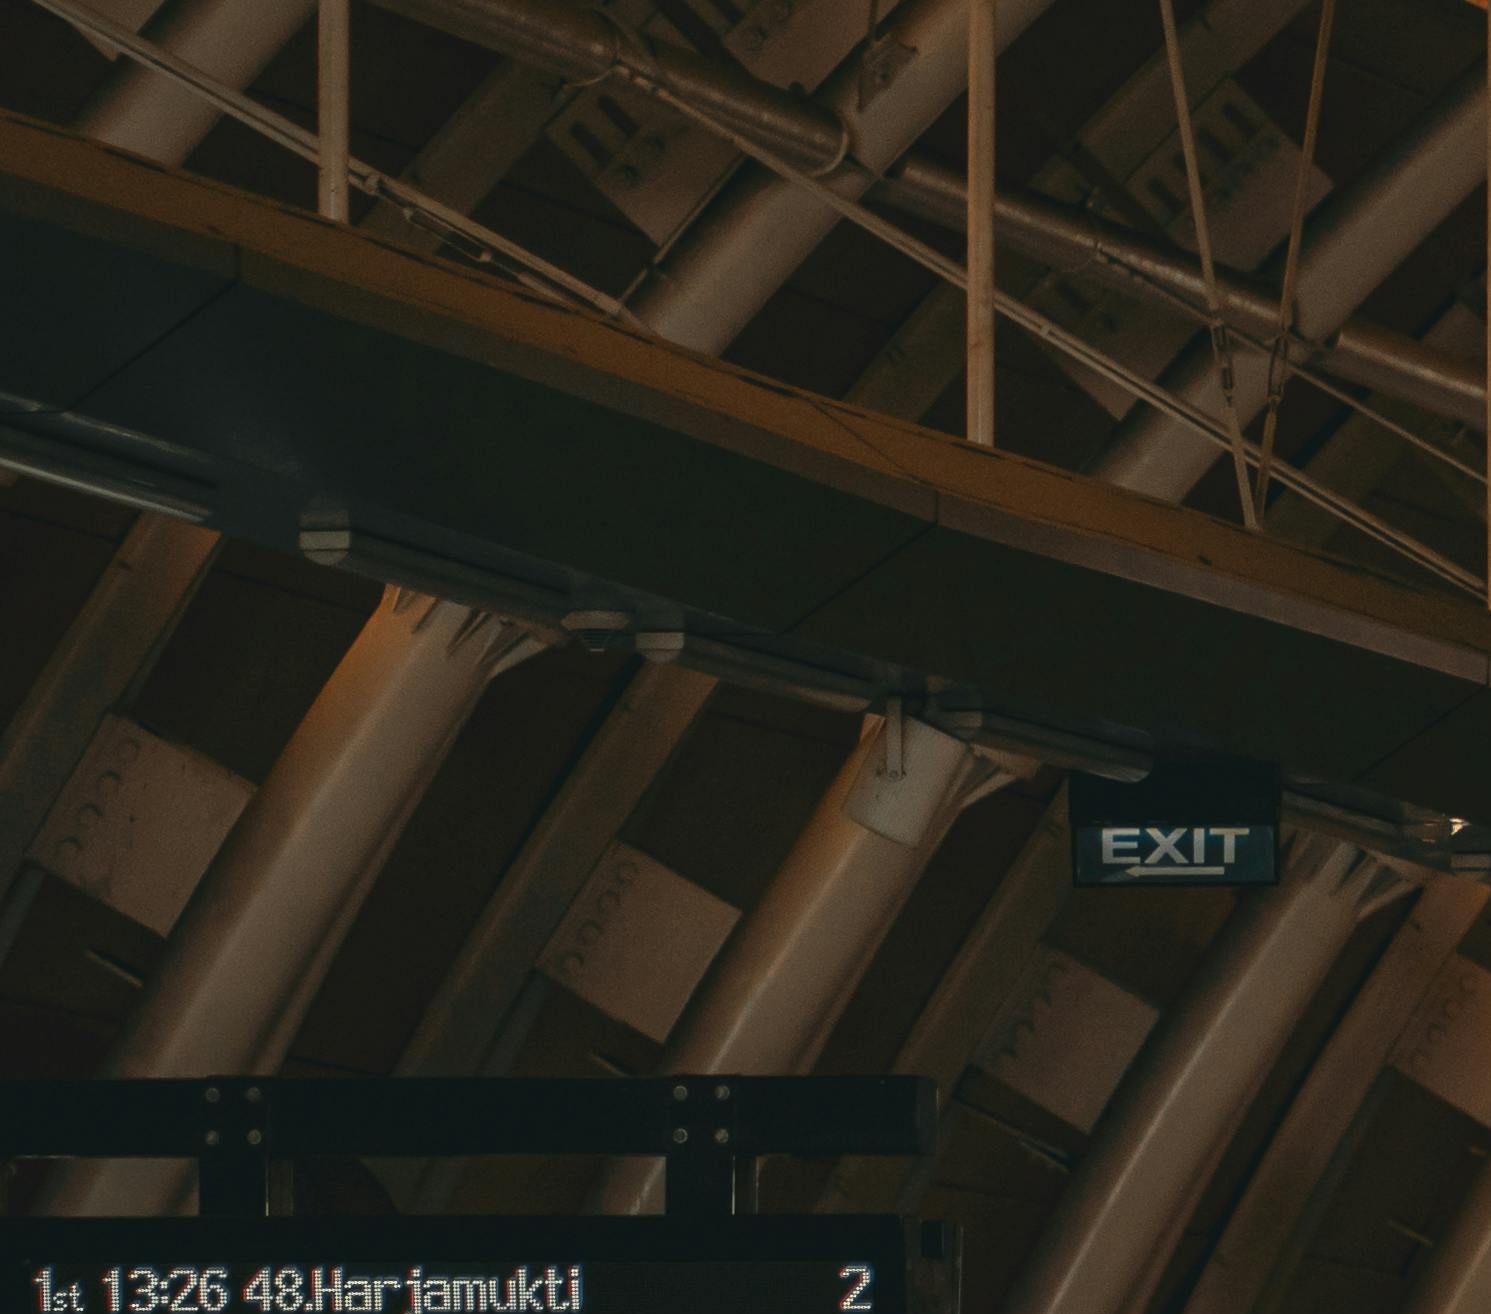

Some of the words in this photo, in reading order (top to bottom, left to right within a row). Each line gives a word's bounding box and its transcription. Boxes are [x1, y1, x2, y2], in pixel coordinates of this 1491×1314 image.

[1101, 827, 1250, 865] EXIT
[34, 1268, 86, 1314] 1st
[102, 1267, 230, 1314] 13:26
[838, 1266, 874, 1312] 2
